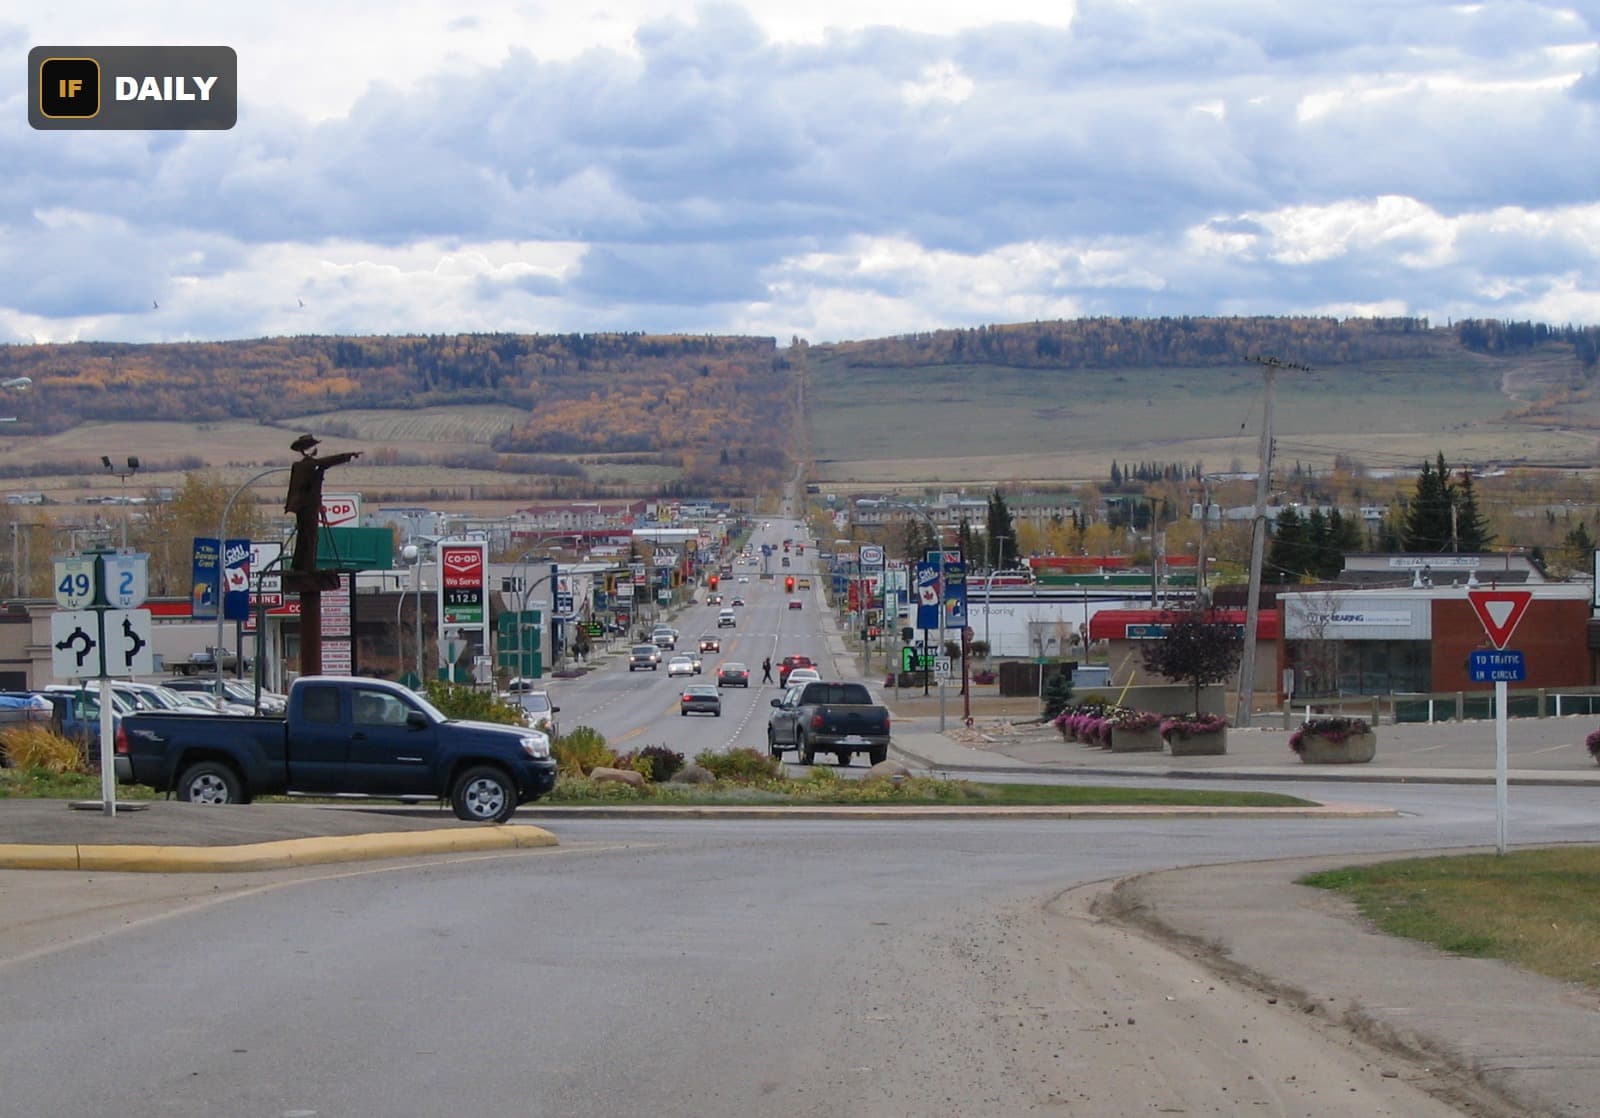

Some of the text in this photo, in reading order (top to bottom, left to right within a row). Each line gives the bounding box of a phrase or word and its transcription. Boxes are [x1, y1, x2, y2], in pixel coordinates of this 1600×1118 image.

[447, 554, 478, 563] CO-OP
[58, 573, 90, 597] 49
[119, 571, 134, 595] 2
[446, 577, 481, 586] We Serve
[449, 594, 478, 603] 112.9
[1476, 655, 1520, 665] TO TRAFFIC
[935, 661, 949, 672] 50
[1476, 670, 1518, 680] IN CIRCLE
